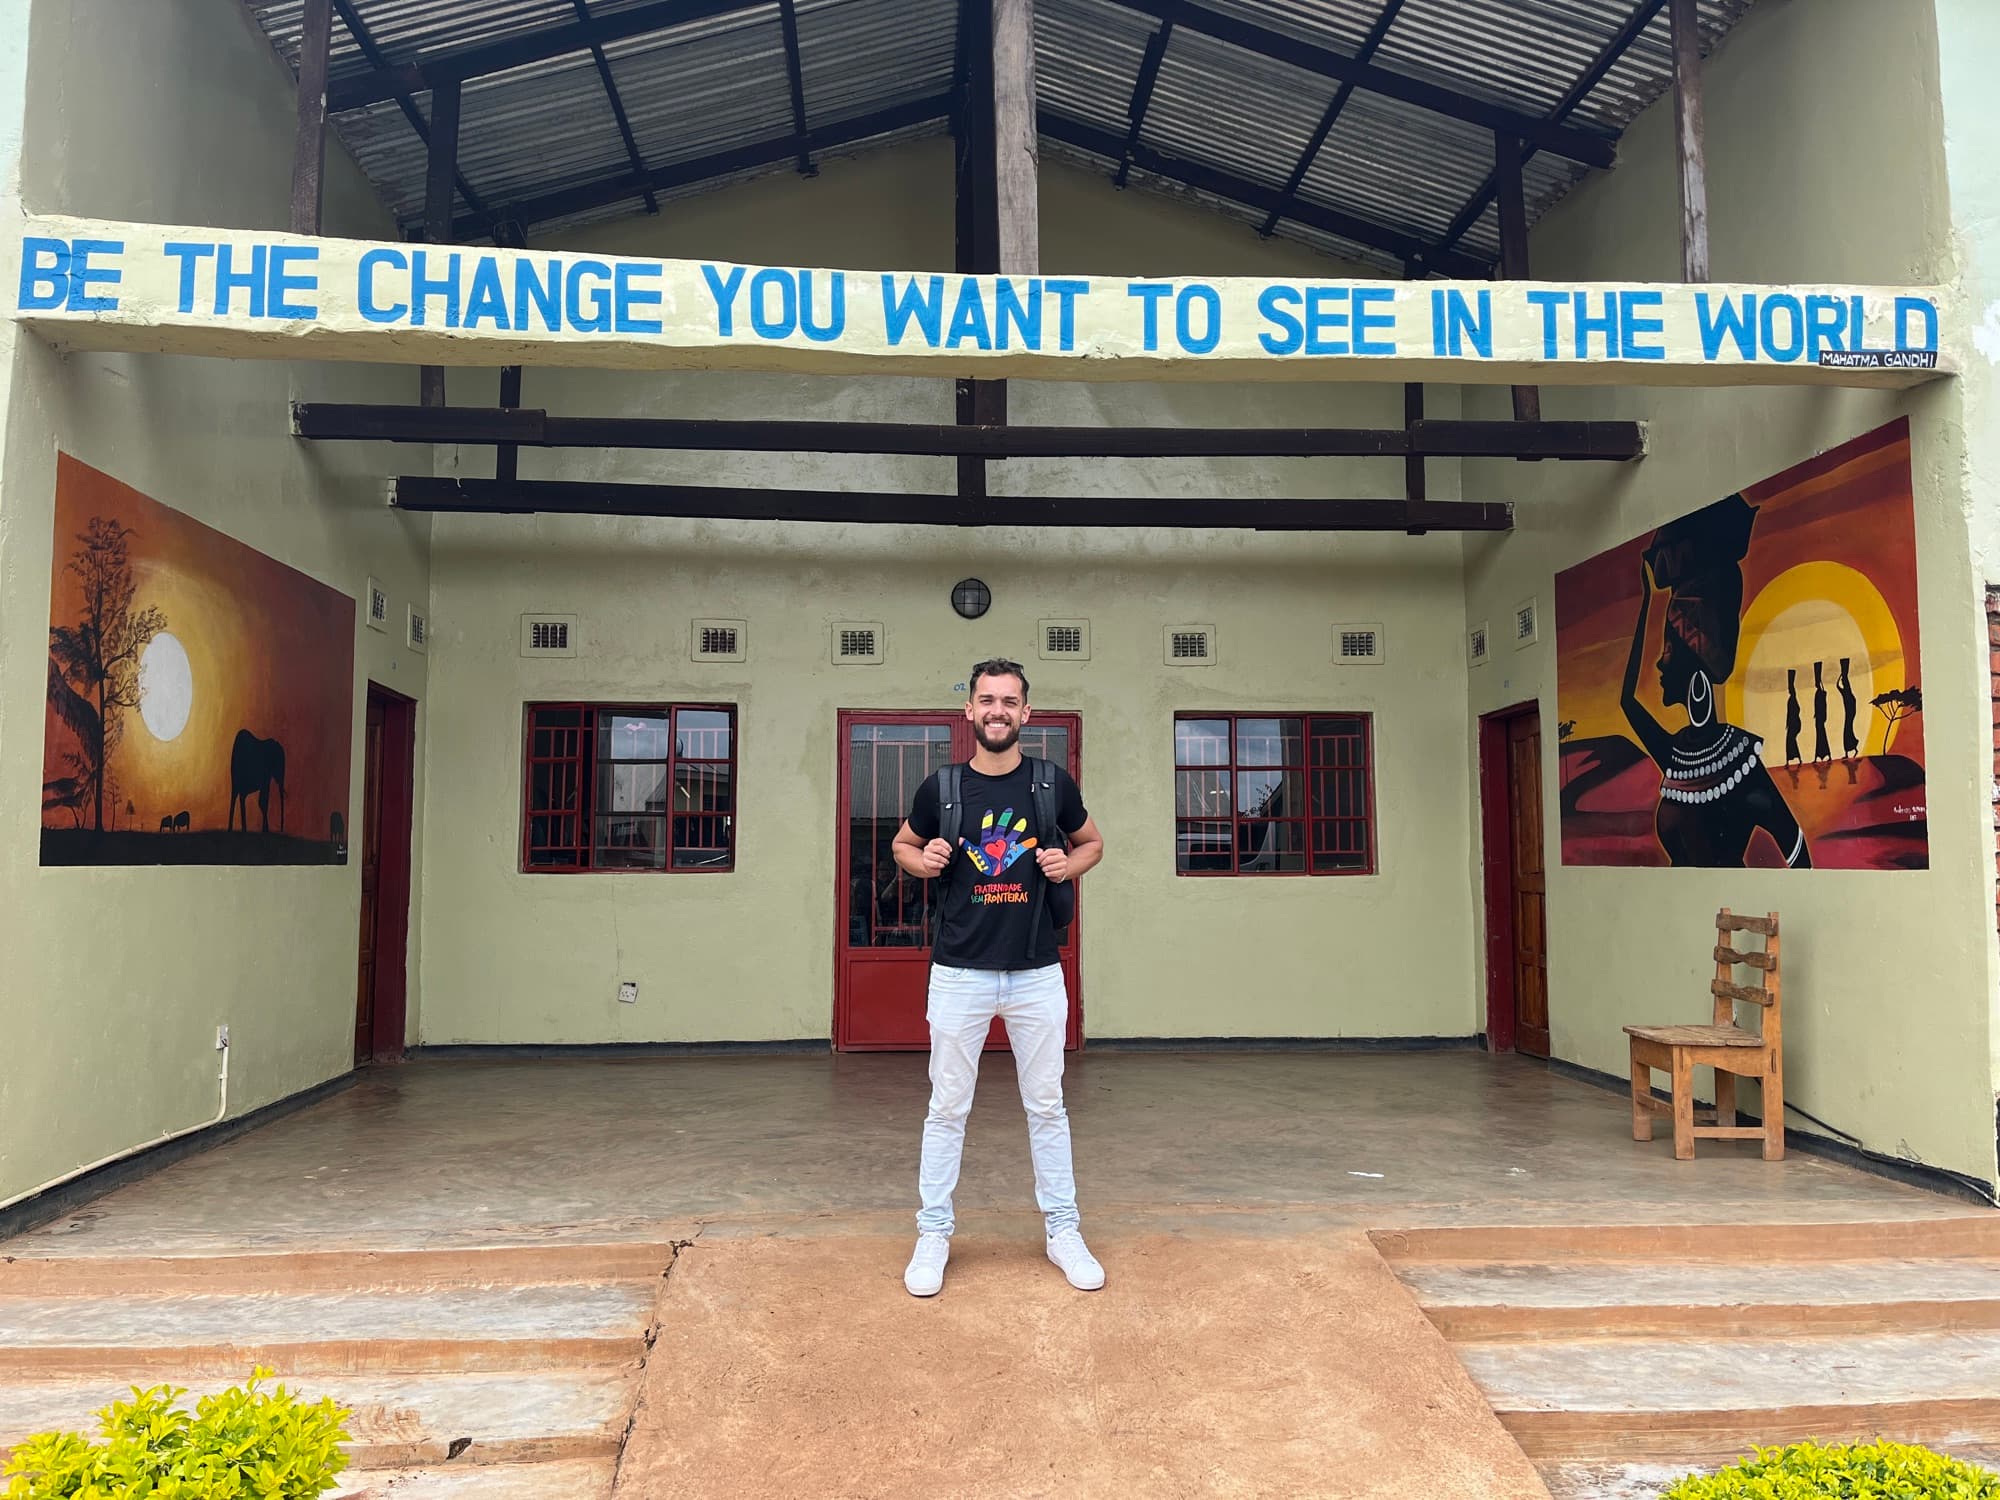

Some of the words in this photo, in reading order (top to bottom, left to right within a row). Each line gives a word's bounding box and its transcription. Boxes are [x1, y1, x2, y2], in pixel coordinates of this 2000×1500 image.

[18, 237, 124, 311] BE
[164, 243, 319, 320] THE
[358, 248, 663, 334] CHANGE
[701, 265, 845, 342] YOU
[882, 274, 1089, 351] WANT
[1128, 283, 1221, 354] TO
[1258, 286, 1396, 355] SEE
[1431, 290, 1493, 358] IN
[1527, 291, 1665, 360] THE
[1695, 293, 1939, 362] WORLD
[1821, 352, 1879, 367] MAHATMA
[1883, 353, 1934, 367] GANDHI
[974, 883, 1022, 895] FRATERNIDADE
[983, 891, 1028, 905] FRONTEIRAS
